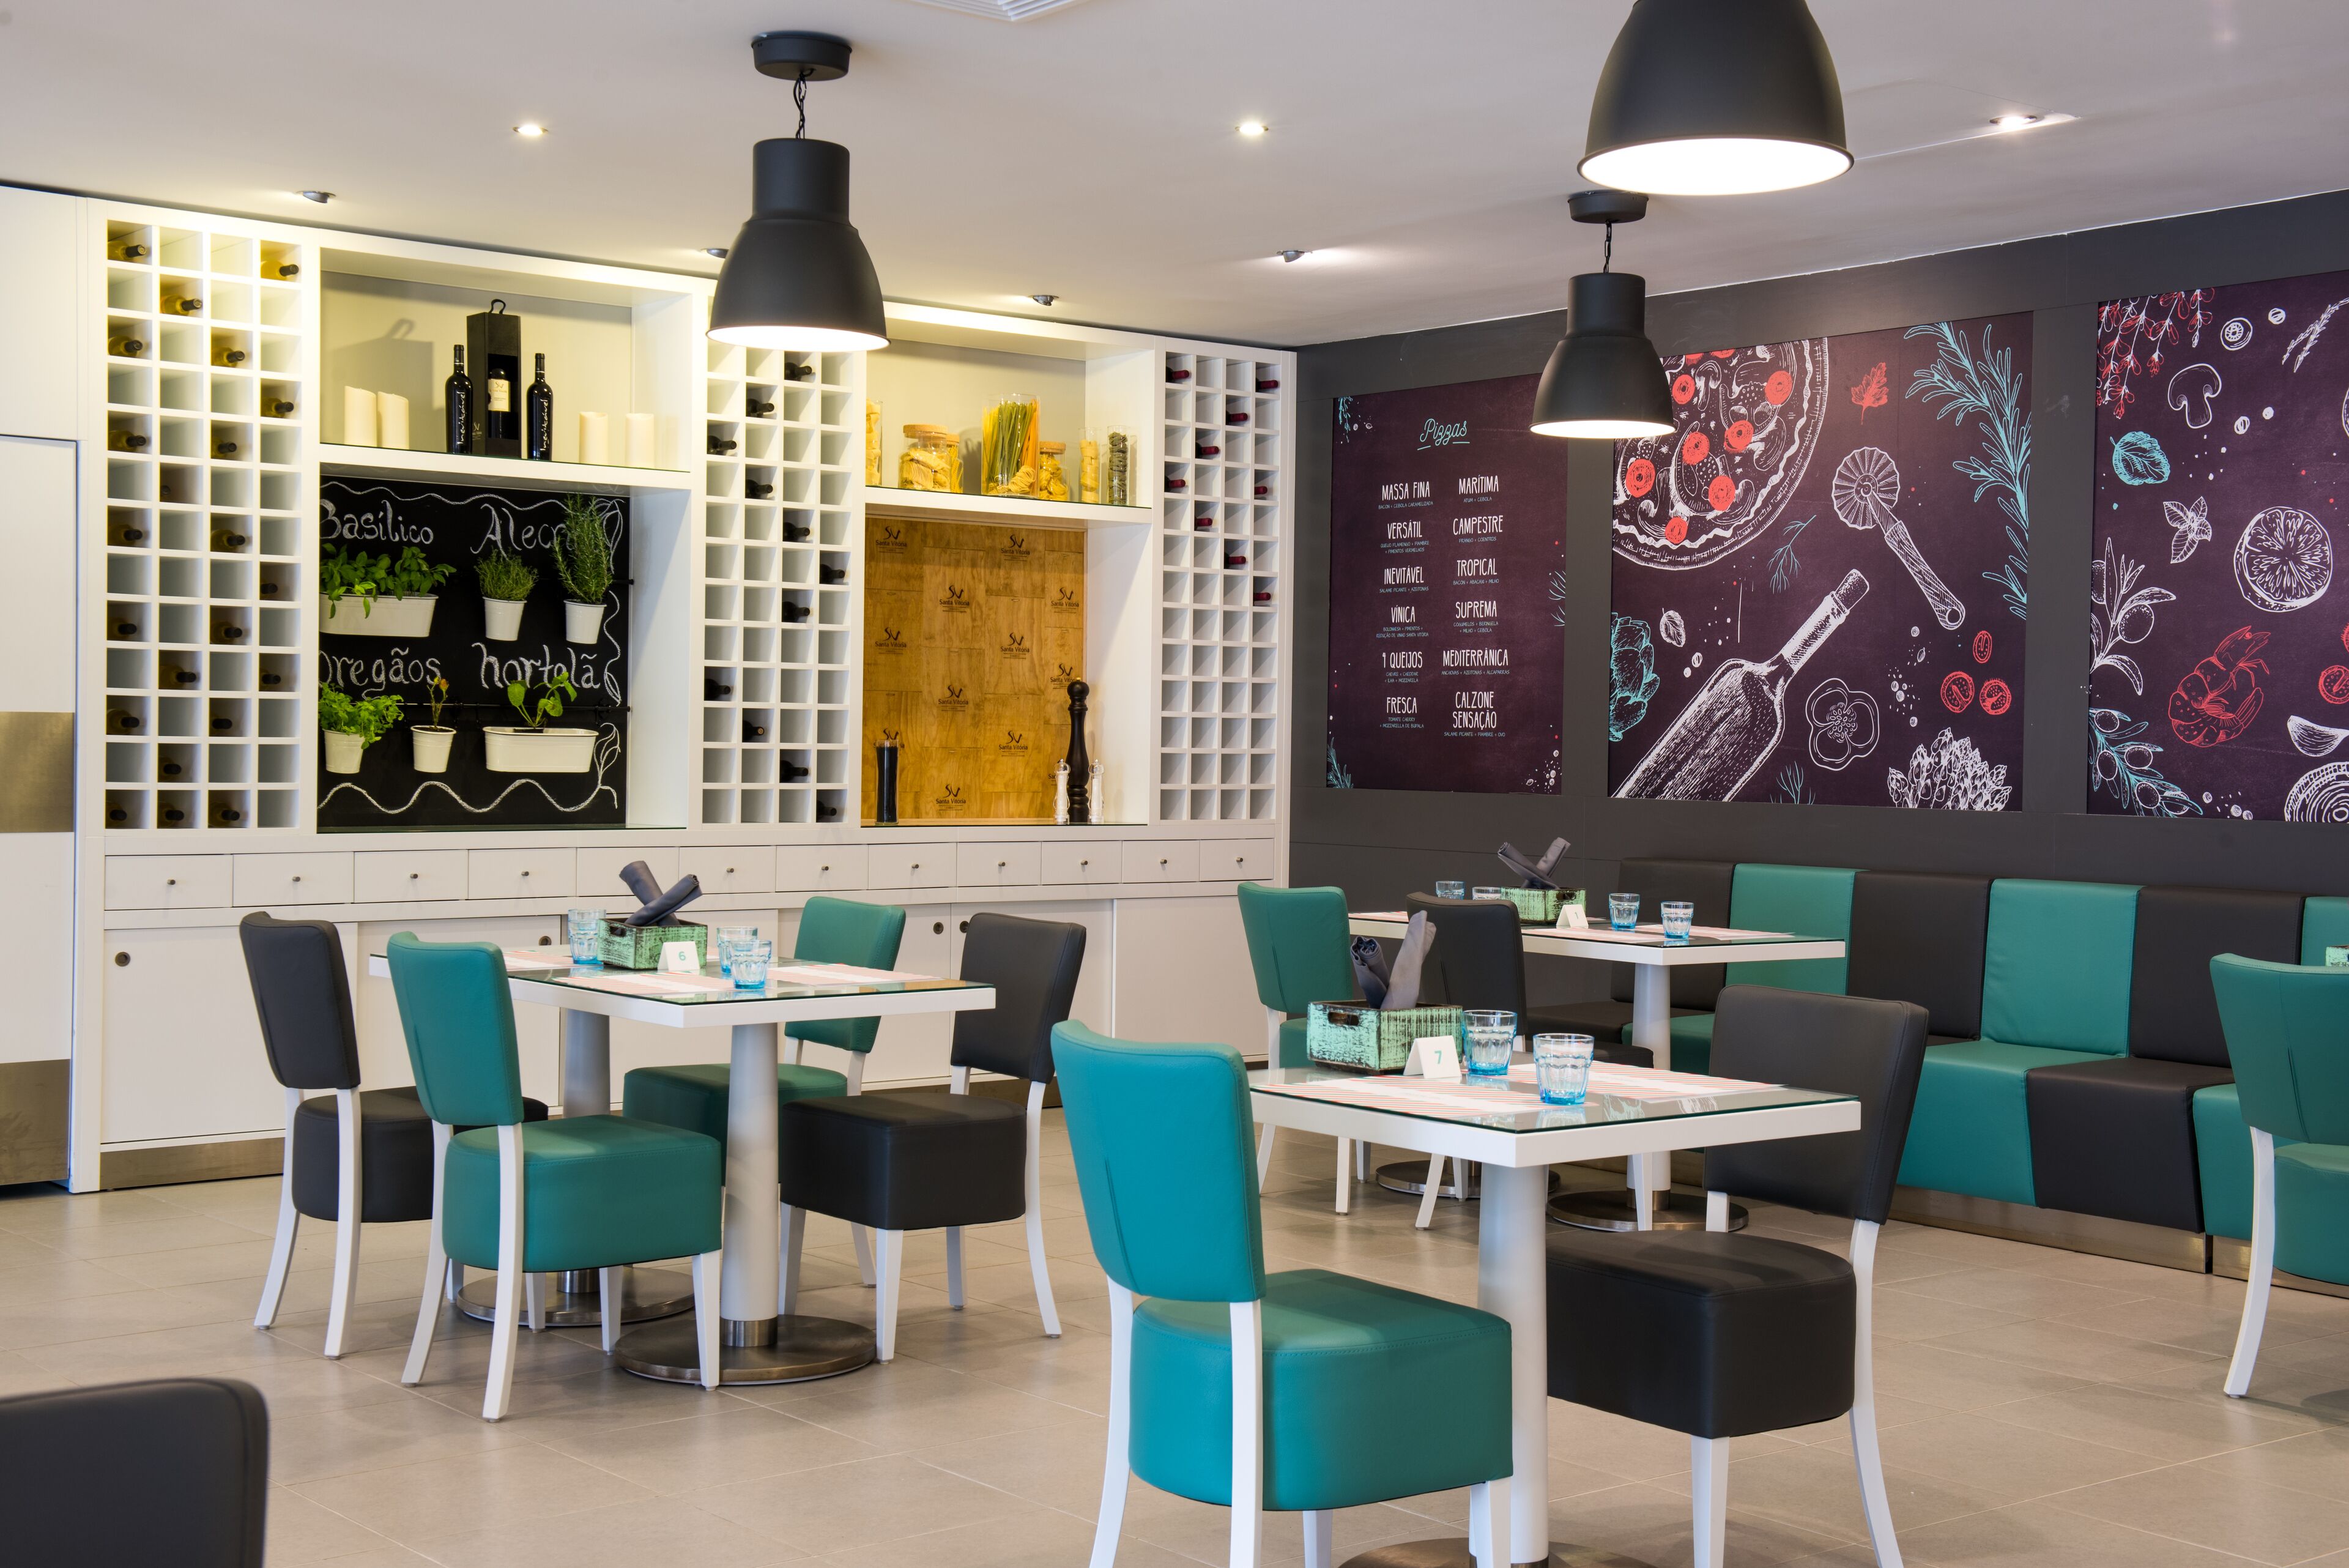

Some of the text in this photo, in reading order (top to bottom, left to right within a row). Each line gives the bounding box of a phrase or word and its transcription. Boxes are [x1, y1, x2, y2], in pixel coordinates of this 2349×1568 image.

[456, 391, 466, 444] Inevitável
[540, 399, 548, 450] Inevitável
[1419, 418, 1467, 446] Pizzas
[1382, 481, 1430, 501] MASSA FINA
[1459, 474, 1499, 495] MARÍTIMA
[319, 499, 434, 544] Basílico
[1387, 519, 1422, 539] VERSÁTIL
[1453, 515, 1504, 535] CAMPESTRE
[470, 503, 574, 561] Alecr
[1384, 565, 1424, 585] INEVITÁVEL
[1457, 558, 1497, 577] TROPICAL
[1391, 604, 1416, 623] VÍNICA
[1455, 600, 1497, 619] SUPREMA
[1390, 652, 1423, 669] QUEIJOS
[1443, 647, 1508, 667] MEDITERRÂNICA
[1387, 697, 1417, 714] FRESCA
[1455, 691, 1494, 708] CALZONE
[1453, 710, 1497, 730] SENSAÇÃO
[678, 951, 686, 961] 6
[1434, 1050, 1442, 1064] 7
